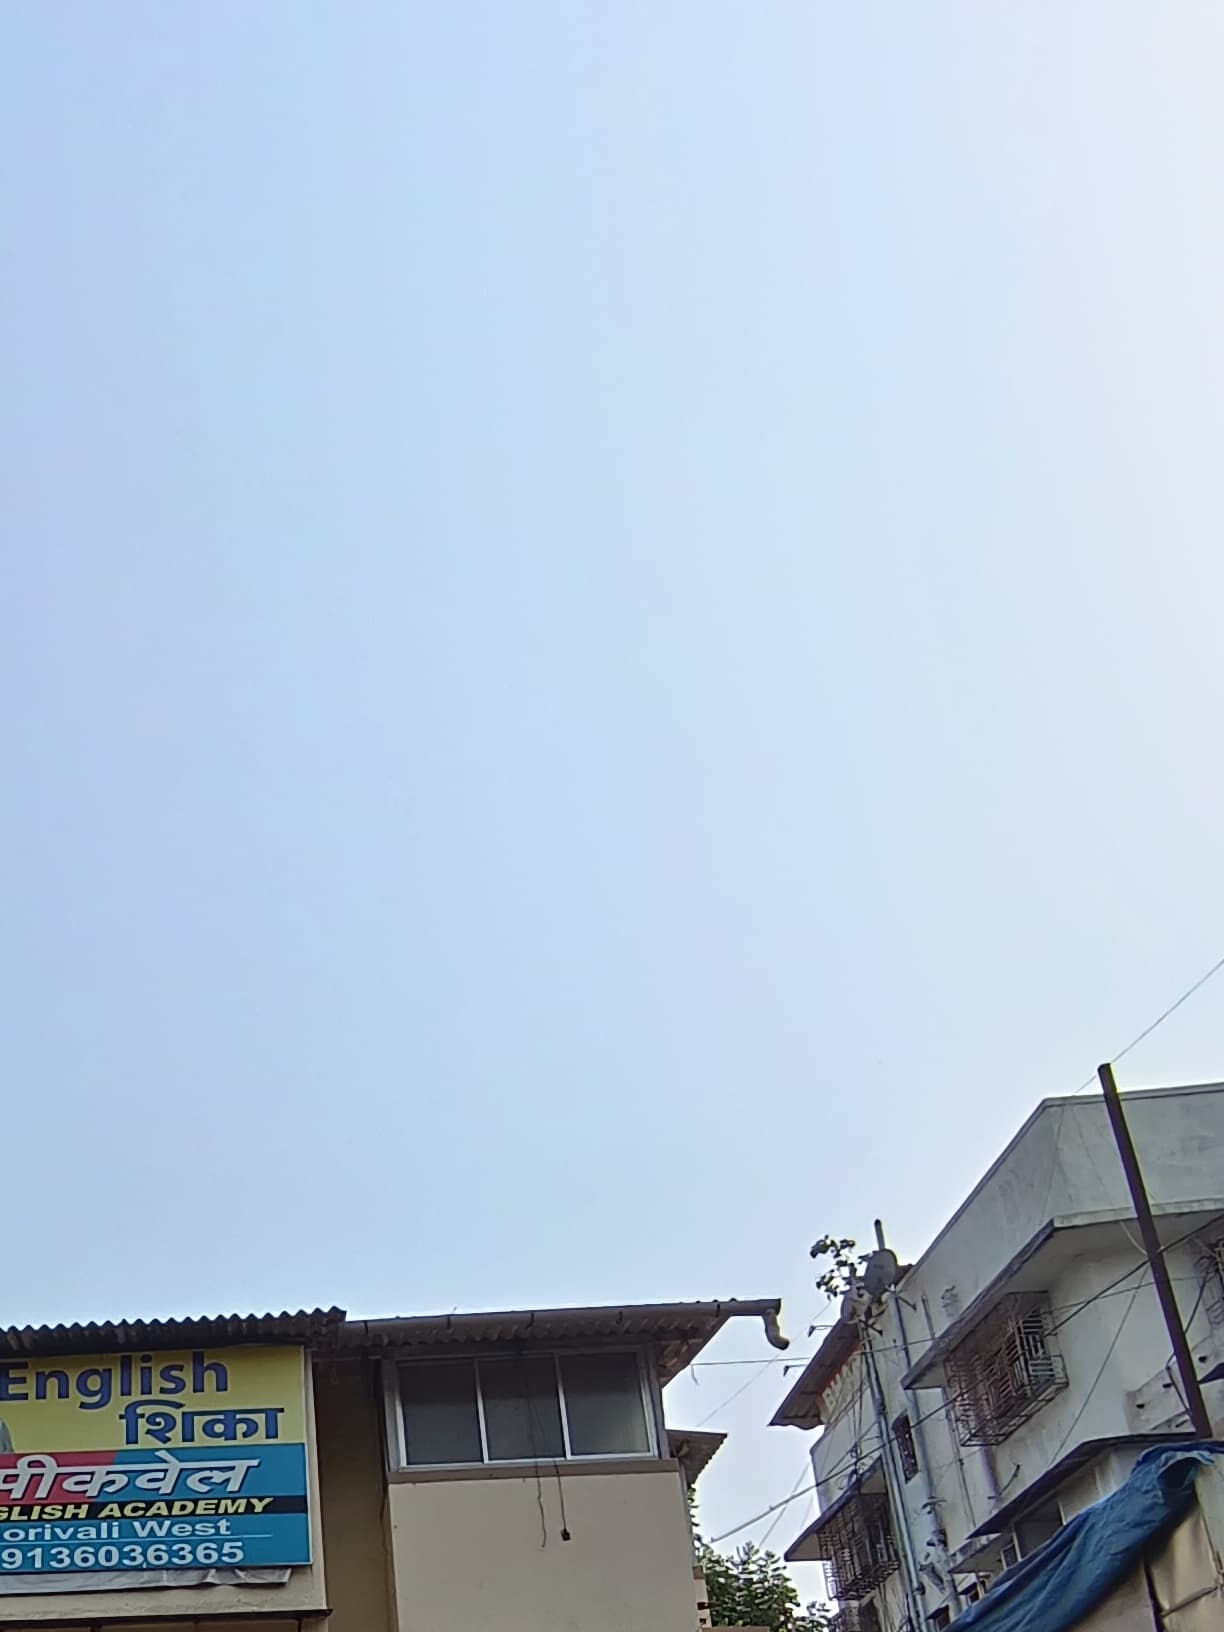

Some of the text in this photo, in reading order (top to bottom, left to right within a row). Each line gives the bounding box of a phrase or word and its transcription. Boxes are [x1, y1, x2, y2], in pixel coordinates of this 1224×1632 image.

[119, 1400, 284, 1446] शिका
[97, 1498, 274, 1518] ACADEMY
[132, 1519, 231, 1538] West
[1, 1542, 245, 1569] 9136036365
